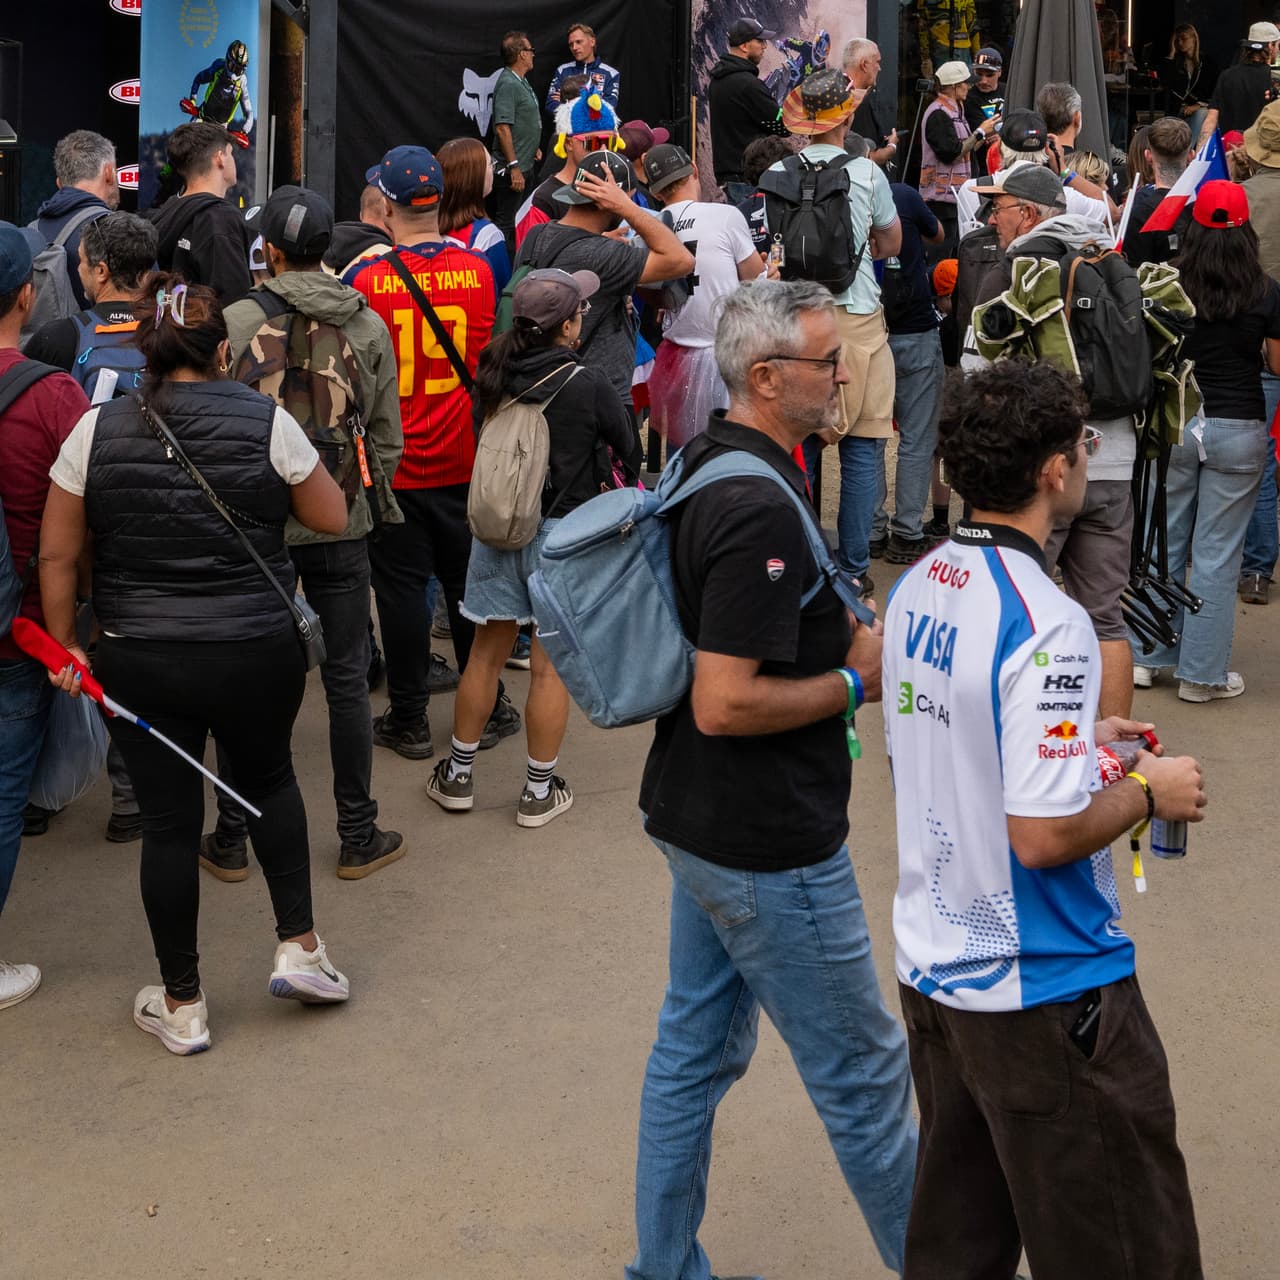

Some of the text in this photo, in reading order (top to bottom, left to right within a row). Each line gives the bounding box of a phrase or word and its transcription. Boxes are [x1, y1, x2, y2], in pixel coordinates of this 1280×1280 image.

[373, 269, 481, 294] LAMNE YAMAL
[393, 305, 468, 397] 19
[927, 558, 971, 590] HUGO
[905, 610, 959, 678] VISA
[1054, 654, 1076, 663] Cash
[1043, 674, 1085, 690] HRC
[1038, 741, 1088, 759] Red ull
